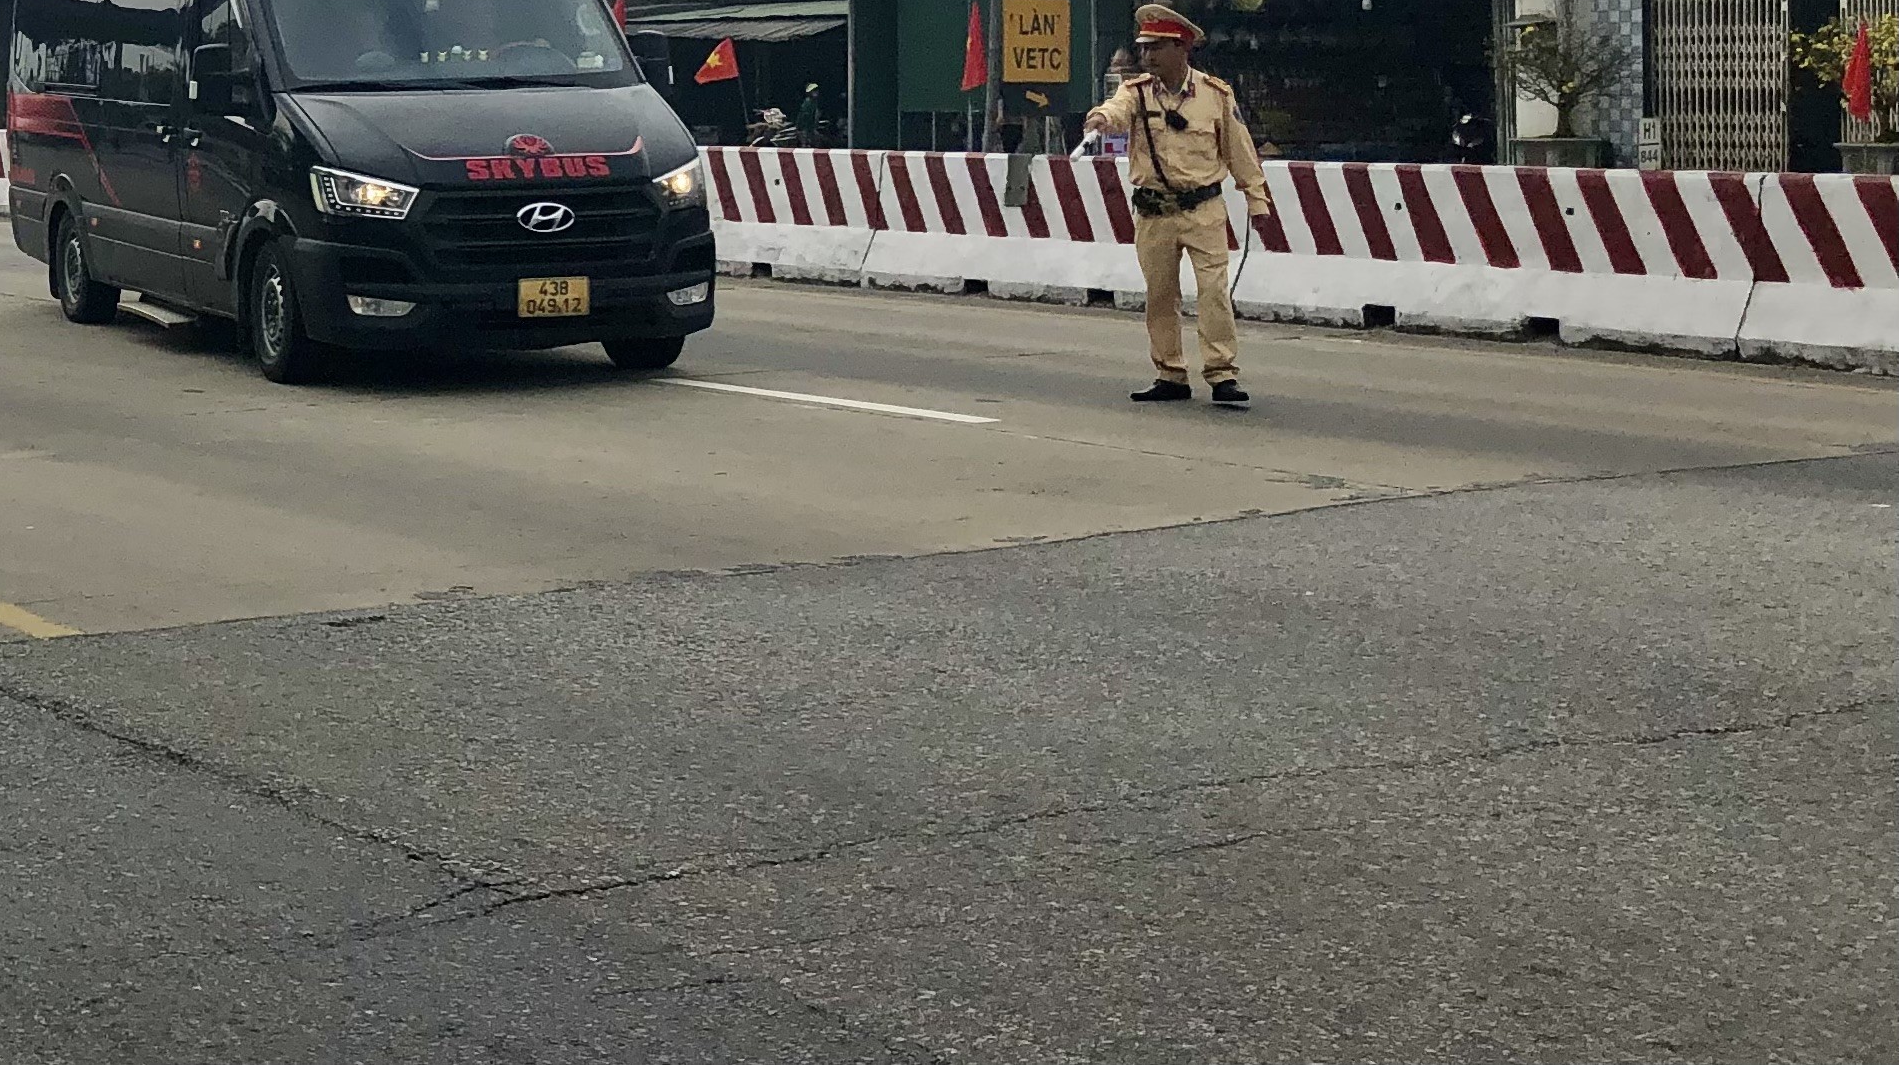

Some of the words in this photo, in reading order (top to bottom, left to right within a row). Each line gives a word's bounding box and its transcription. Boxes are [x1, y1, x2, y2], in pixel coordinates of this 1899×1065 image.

[1013, 46, 1062, 70] VETC
[465, 155, 611, 181] SKYBUS
[538, 280, 569, 296] 43B
[526, 297, 582, 314] 049.12
